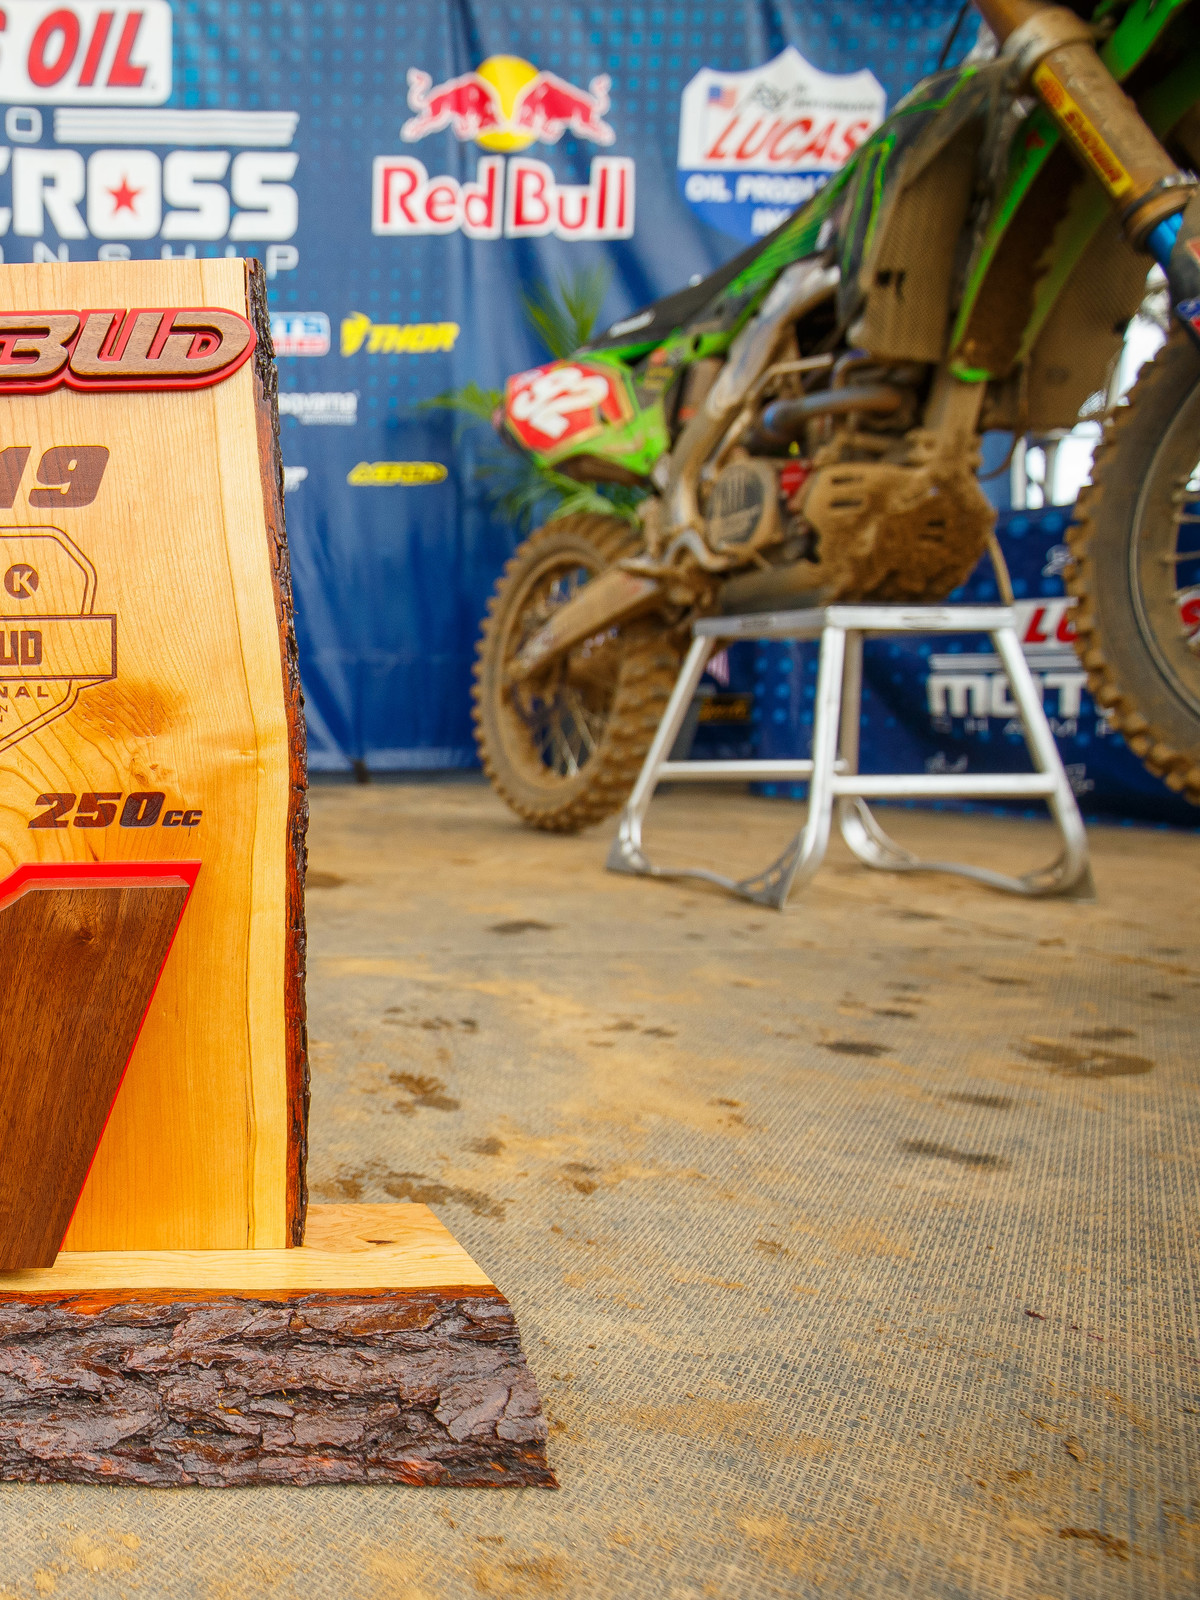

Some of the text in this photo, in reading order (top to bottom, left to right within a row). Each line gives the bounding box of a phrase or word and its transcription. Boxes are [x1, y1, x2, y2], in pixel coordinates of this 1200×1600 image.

[27, 7, 148, 89] OIL
[706, 116, 870, 164] LUCAS
[377, 161, 630, 236] Red Bull
[685, 174, 732, 203] OIL
[3, 563, 39, 599] K
[27, 791, 204, 829] 250cc
